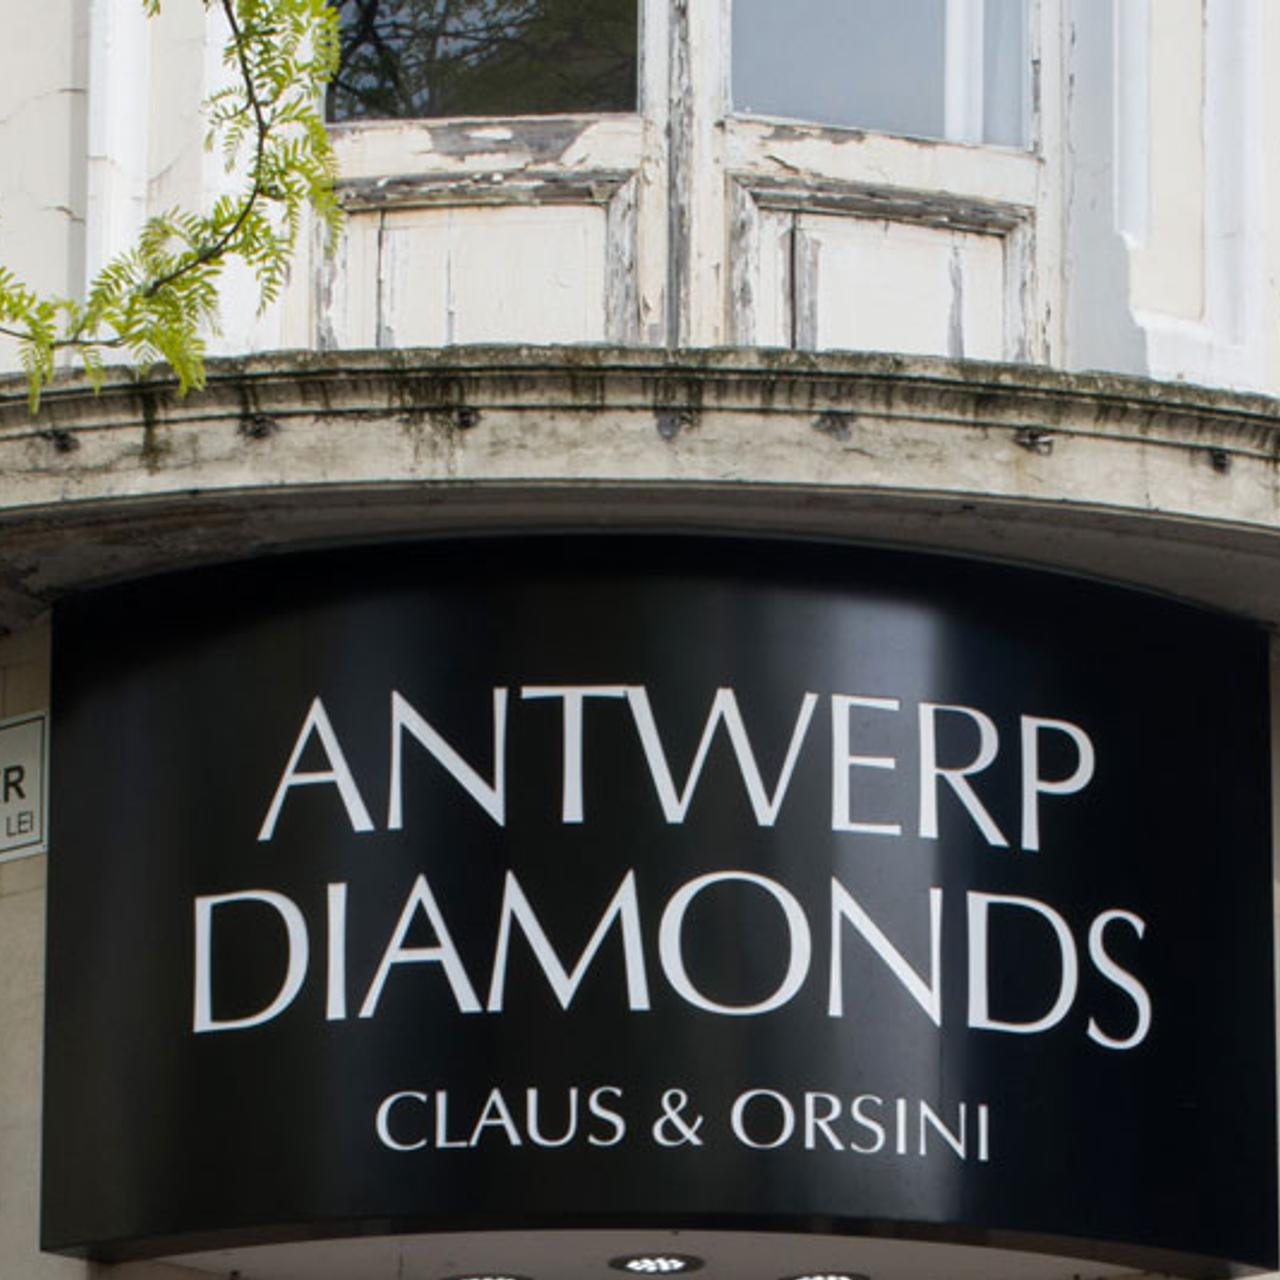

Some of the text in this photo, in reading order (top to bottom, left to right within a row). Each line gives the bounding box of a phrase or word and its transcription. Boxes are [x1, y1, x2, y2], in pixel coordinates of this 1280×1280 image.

[6, 810, 34, 837] LEI
[258, 685, 1095, 851] ANTWERP
[193, 870, 1152, 1050] DIAMONDS
[376, 1086, 989, 1161] CLAUS & ORSINI
